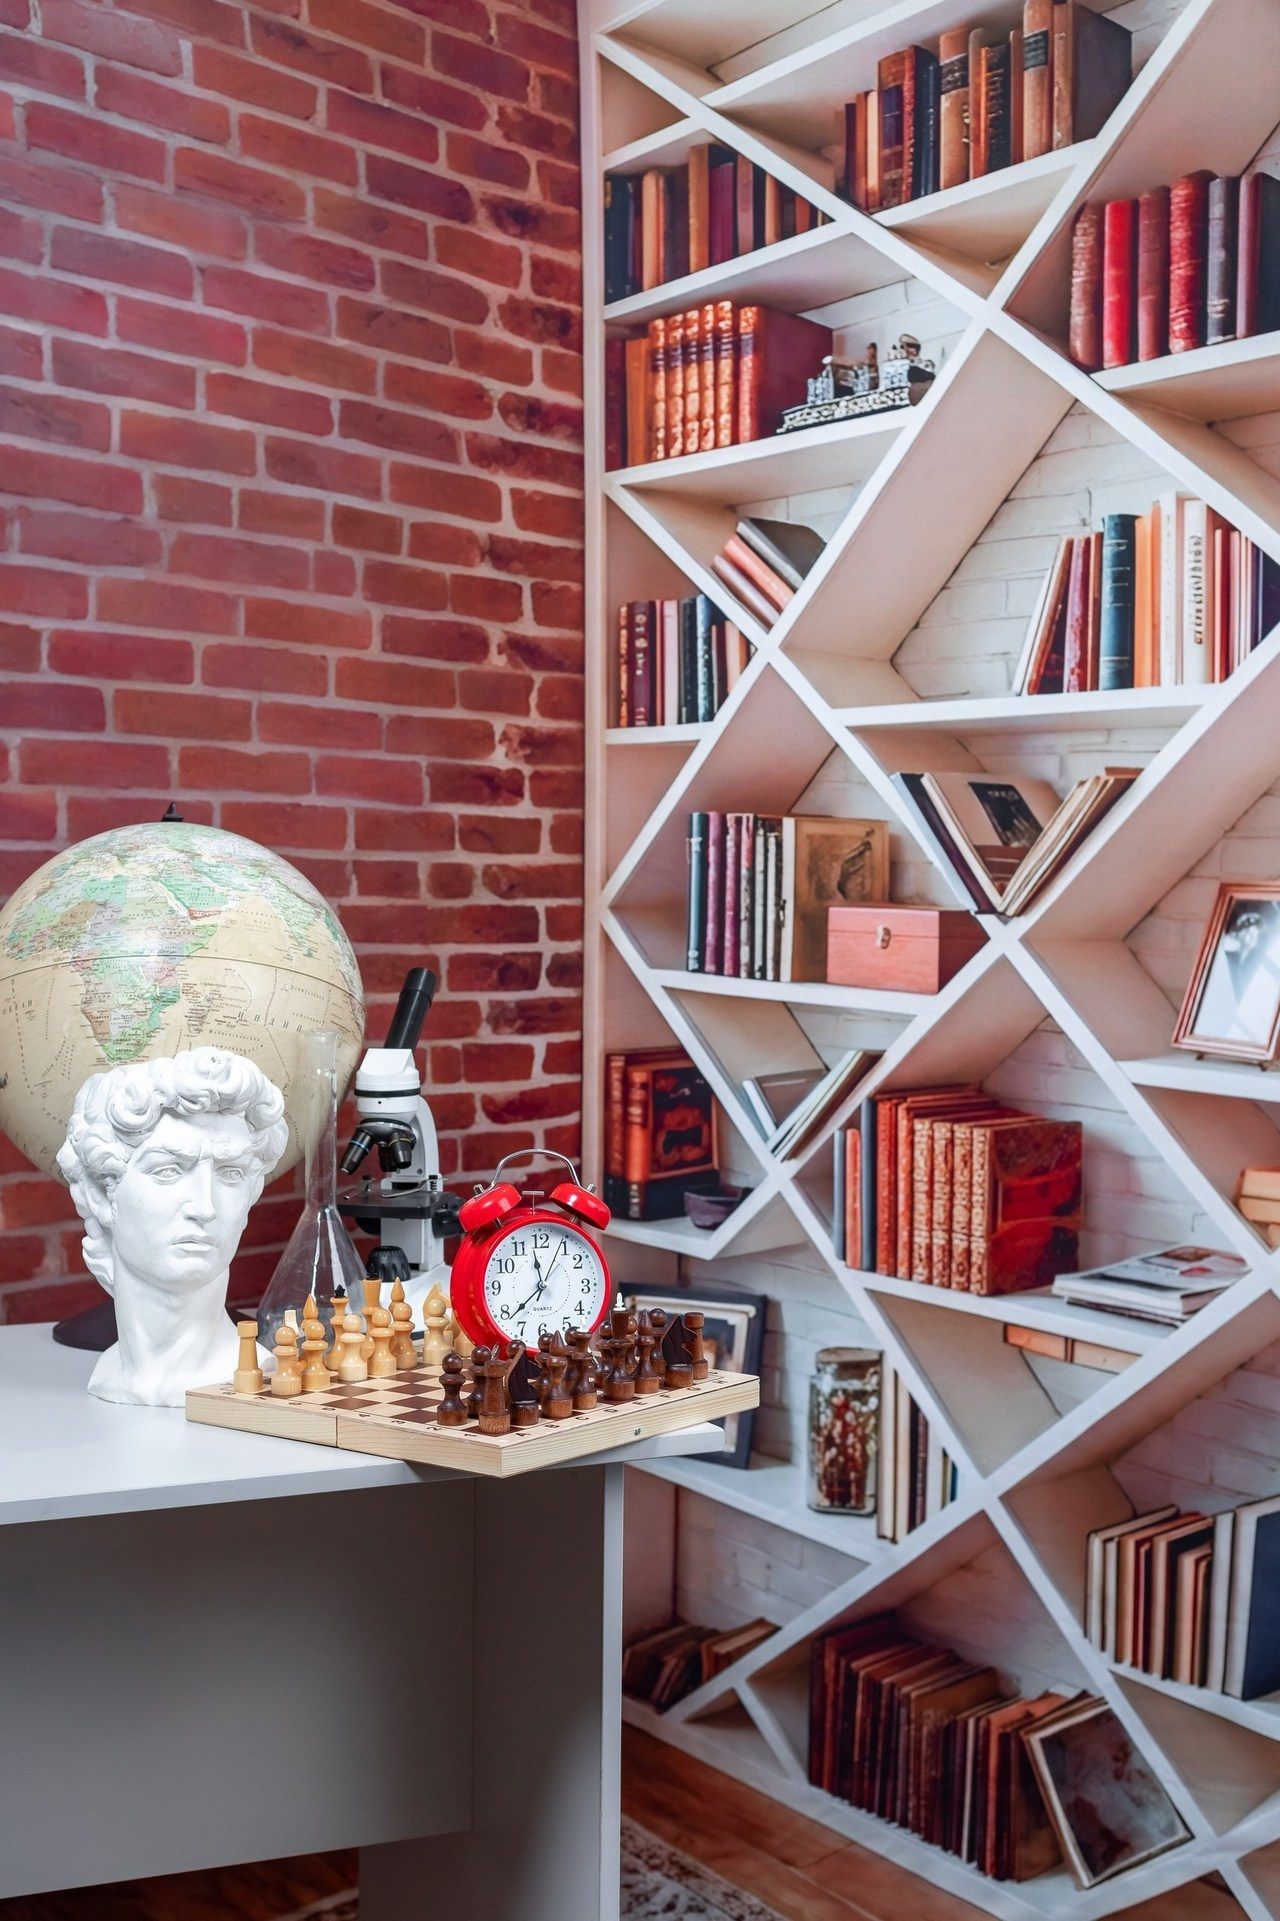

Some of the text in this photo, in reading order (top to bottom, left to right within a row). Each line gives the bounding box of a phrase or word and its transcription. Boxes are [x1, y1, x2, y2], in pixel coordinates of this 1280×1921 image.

[511, 1240, 528, 1257] 11
[531, 1233, 550, 1249] 12
[561, 1240, 570, 1256] 1
[496, 1258, 515, 1274] 10
[573, 1254, 583, 1269] 2
[491, 1280, 502, 1296] 9
[581, 1278, 591, 1294] 3
[500, 1304, 511, 1320] 8
[574, 1300, 585, 1315] 4
[517, 1321, 527, 1337] 7
[537, 1323, 548, 1336] 6
[562, 1316, 572, 1331] 5
